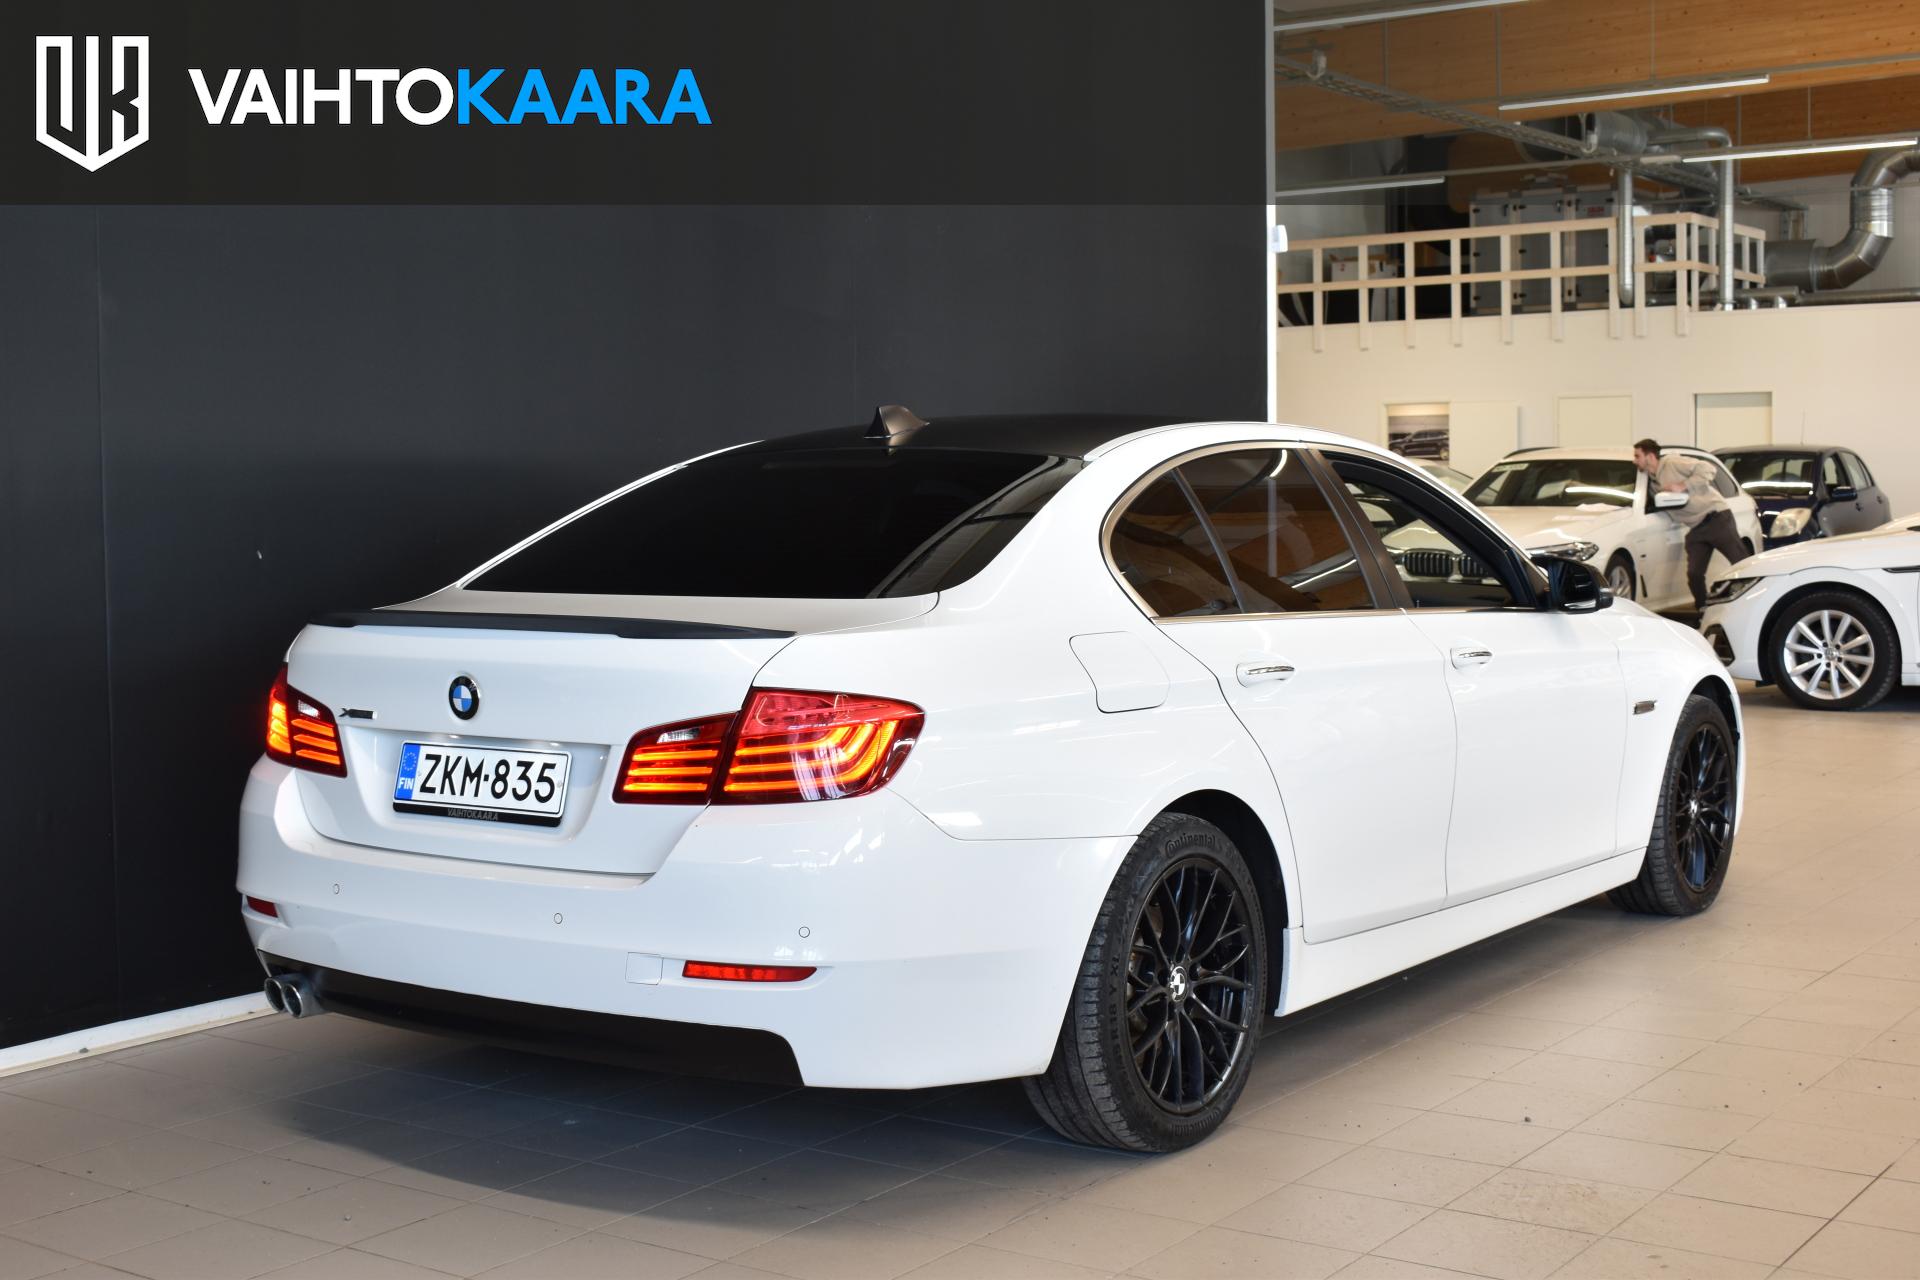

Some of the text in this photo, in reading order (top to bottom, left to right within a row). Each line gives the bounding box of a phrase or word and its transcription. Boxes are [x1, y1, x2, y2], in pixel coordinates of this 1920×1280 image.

[398, 776, 415, 790] FIN
[447, 807, 499, 821] VAIHTOKAARA
[1165, 832, 1217, 858] Continental
